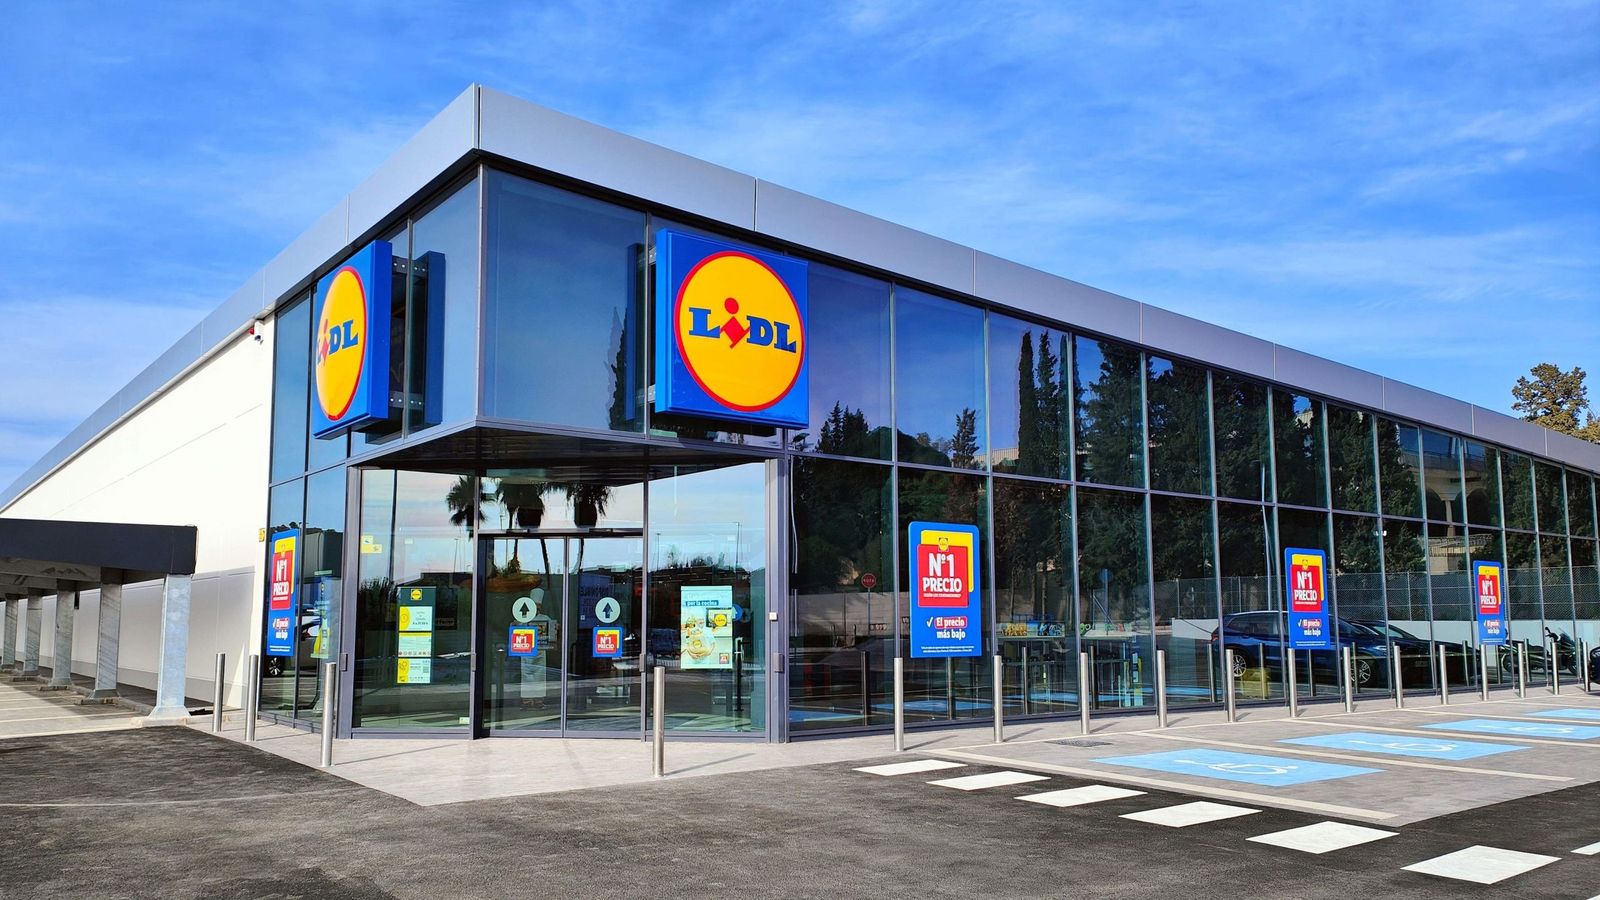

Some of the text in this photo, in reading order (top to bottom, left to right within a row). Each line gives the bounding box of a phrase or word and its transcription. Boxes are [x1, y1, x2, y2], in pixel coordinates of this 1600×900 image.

[922, 577, 963, 593] PRECIO
[1294, 589, 1318, 601] PRECIO
[936, 617, 965, 629] El precio
[936, 628, 966, 641] más bajo
